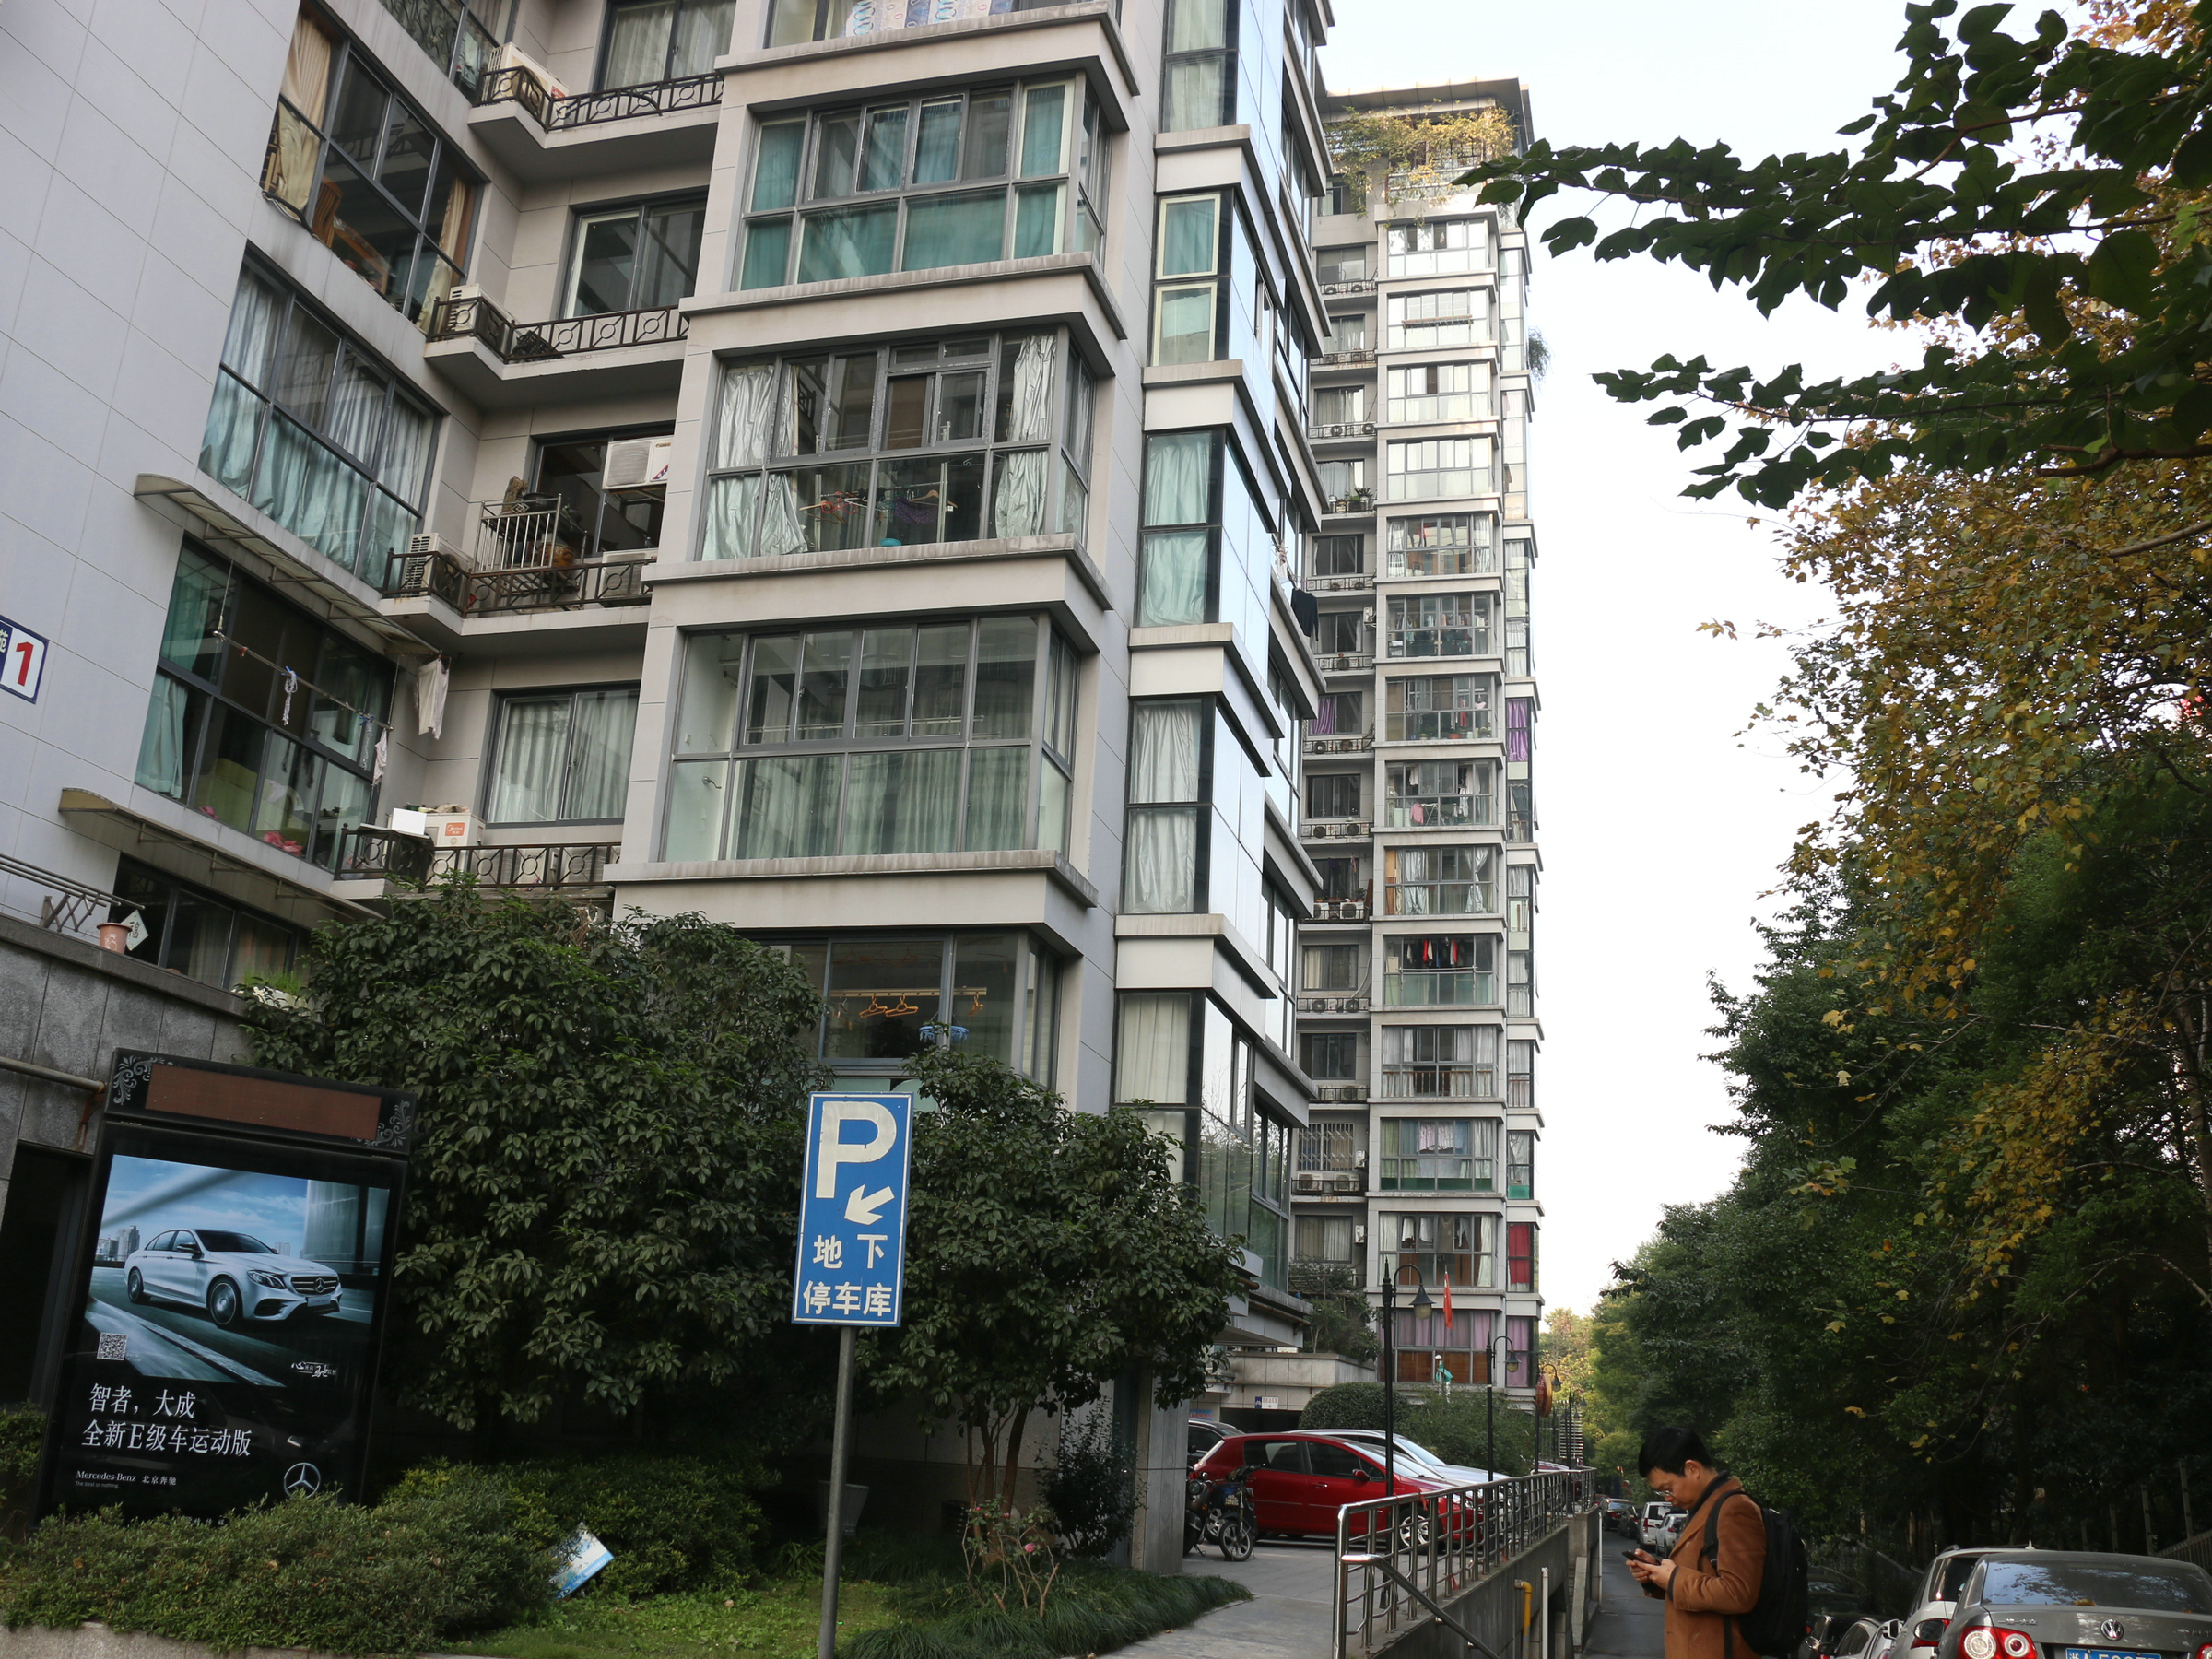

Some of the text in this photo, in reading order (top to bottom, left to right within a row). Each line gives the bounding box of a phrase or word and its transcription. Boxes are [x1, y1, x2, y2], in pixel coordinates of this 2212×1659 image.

[16, 641, 34, 687] 1
[816, 1101, 897, 1198] P
[812, 1234, 888, 1269] 地下
[803, 1280, 892, 1317] 停车库
[81, 1419, 253, 1456] 全新E级车运动版
[76, 1470, 177, 1486] Mercedes-Benz 北京奔驰
